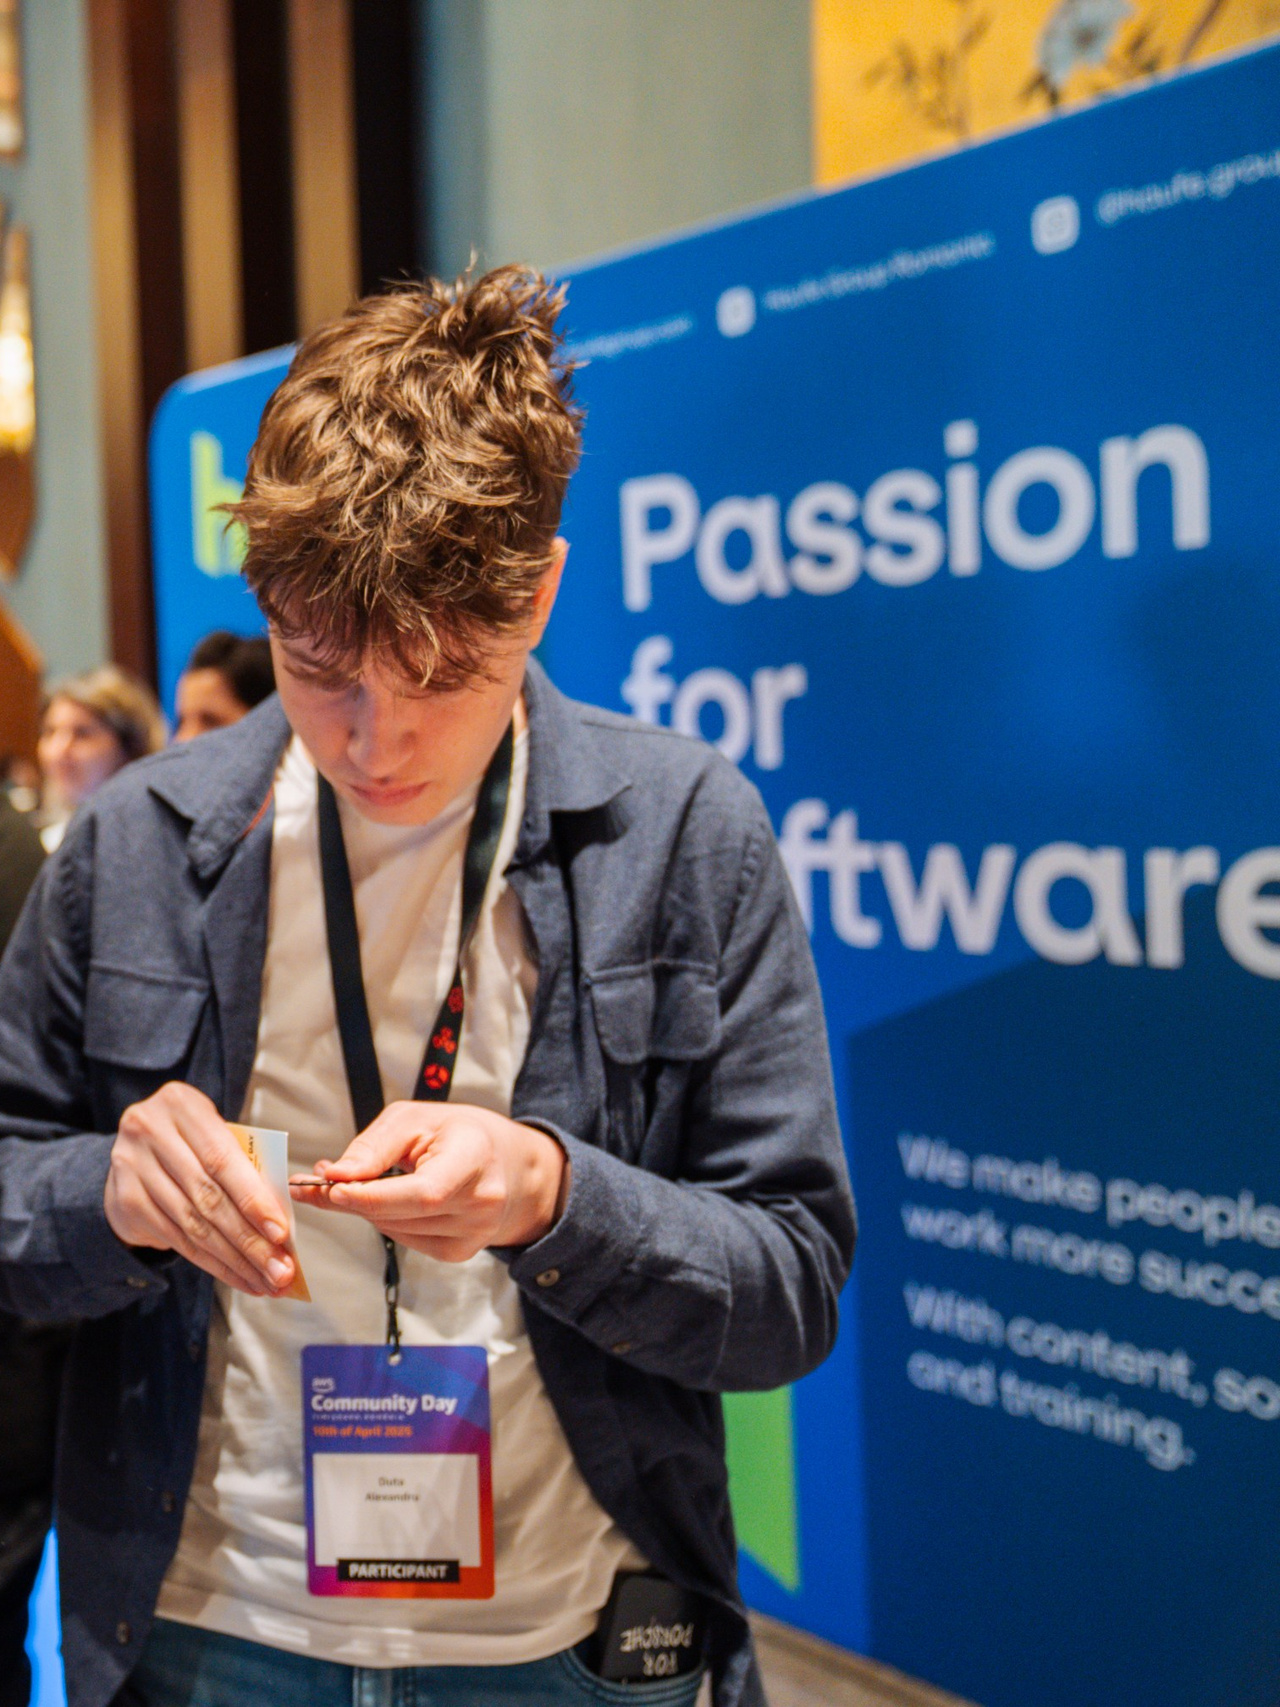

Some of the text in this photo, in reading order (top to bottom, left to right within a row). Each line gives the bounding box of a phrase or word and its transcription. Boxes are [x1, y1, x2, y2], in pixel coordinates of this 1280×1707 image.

[620, 419, 1212, 613] Passion
[621, 635, 809, 771] for
[896, 1132, 1280, 1249] We make people
[901, 1203, 1010, 1257] work
[1011, 1224, 1135, 1285] more
[311, 1394, 458, 1416] Community Day
[904, 1281, 1280, 1421] With content, so
[907, 1350, 1197, 1472] and training.
[348, 1564, 448, 1578] PARTICIPANT
